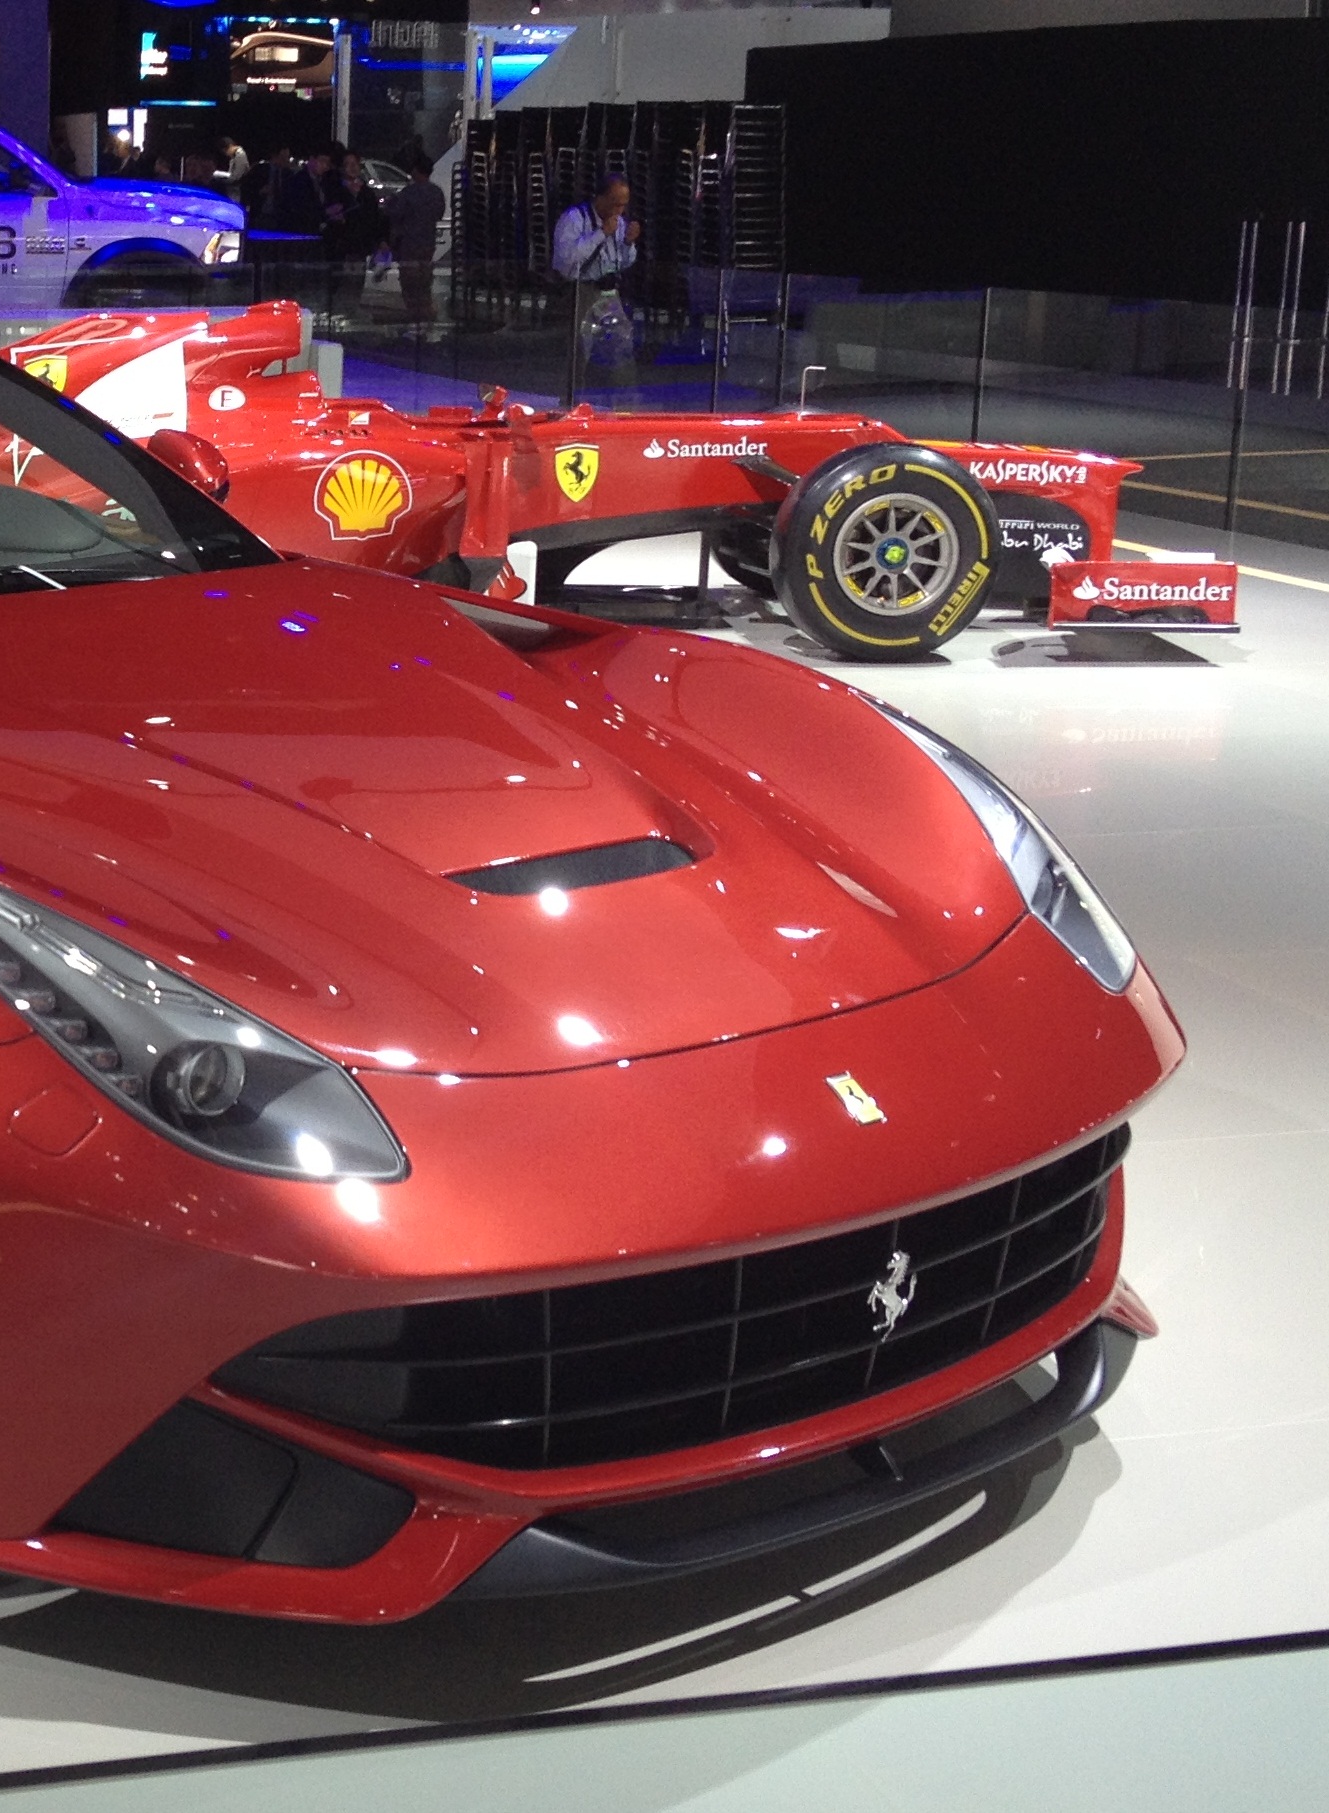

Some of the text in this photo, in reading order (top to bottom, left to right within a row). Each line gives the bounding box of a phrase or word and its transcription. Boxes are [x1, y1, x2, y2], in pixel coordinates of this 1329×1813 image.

[667, 436, 768, 458] Santander
[970, 459, 1077, 486] KASPERSKY
[809, 464, 897, 545] ZERO
[1037, 522, 1080, 530] WORLD
[1033, 533, 1083, 551] Dhabi
[806, 553, 824, 579] P
[927, 561, 991, 637] PIRELLI
[1103, 577, 1232, 602] Santander
